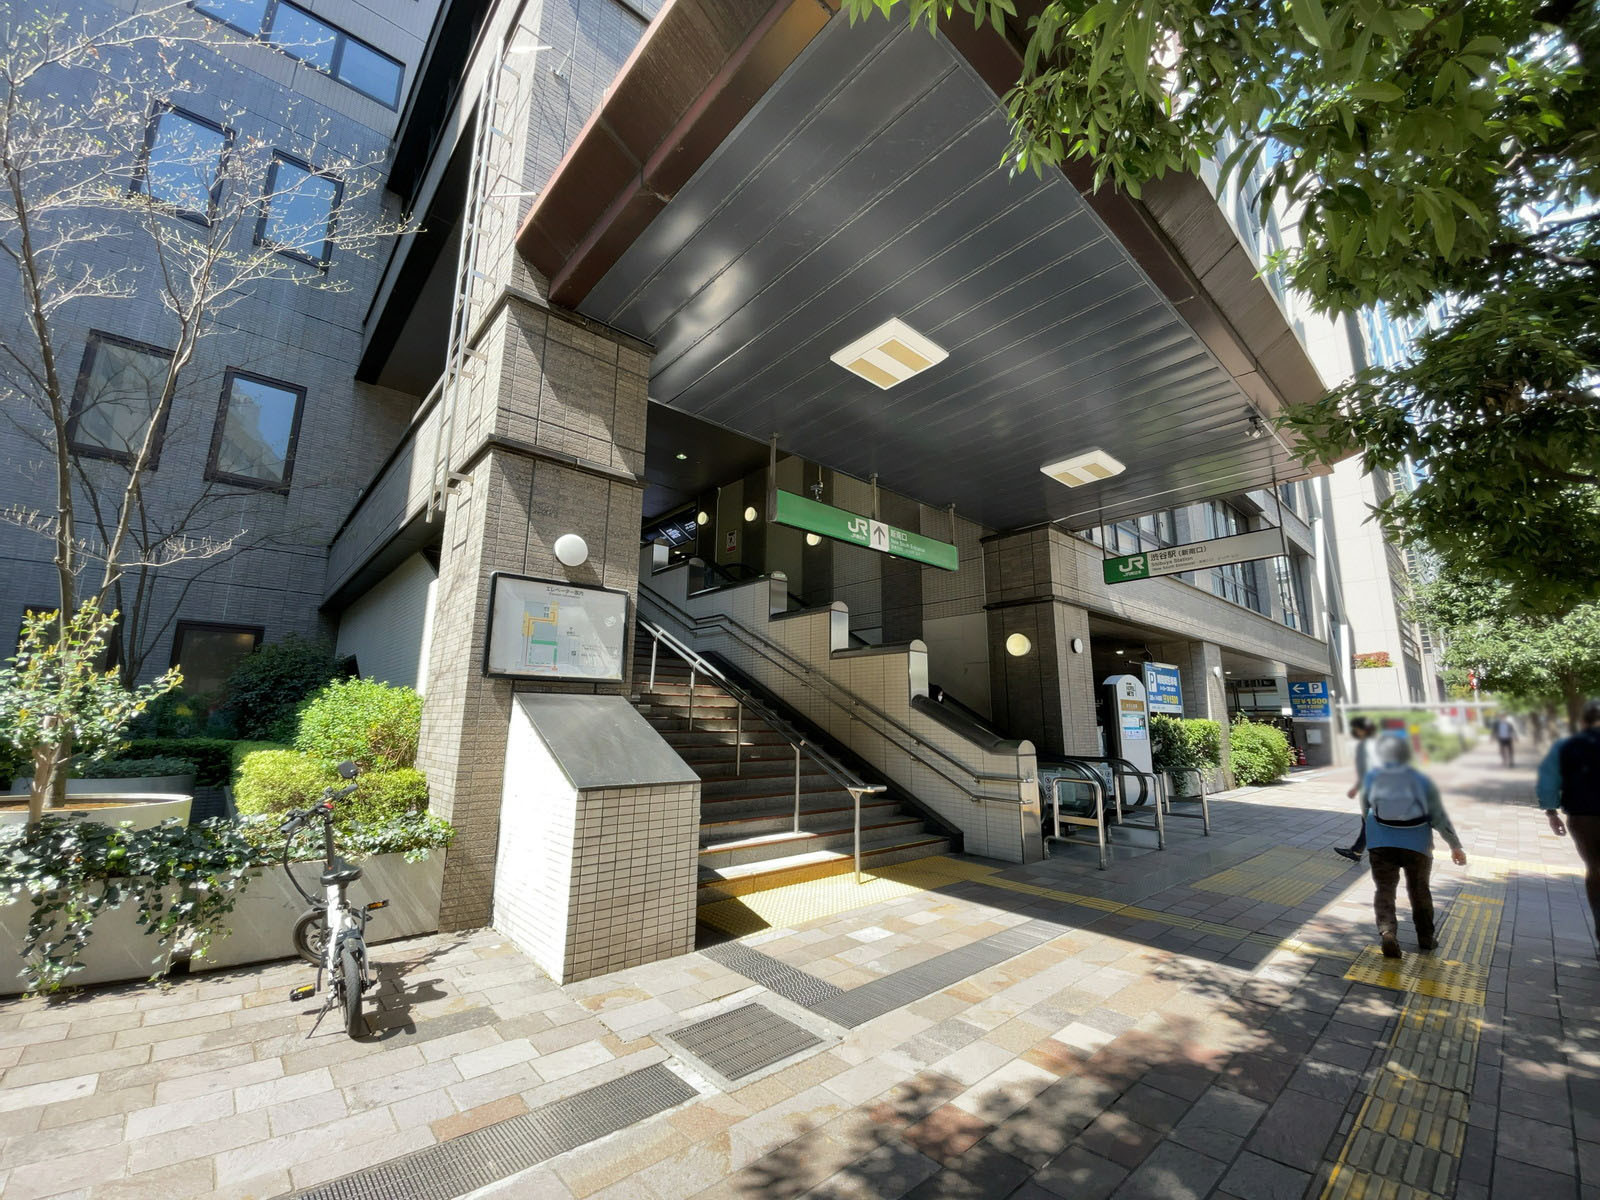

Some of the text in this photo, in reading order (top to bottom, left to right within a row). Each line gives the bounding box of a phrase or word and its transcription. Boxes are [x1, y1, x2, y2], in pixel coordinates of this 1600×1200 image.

[848, 518, 867, 537] JR
[1119, 556, 1144, 572] JR
[1173, 556, 1194, 564] Station
[1312, 684, 1318, 692] P
